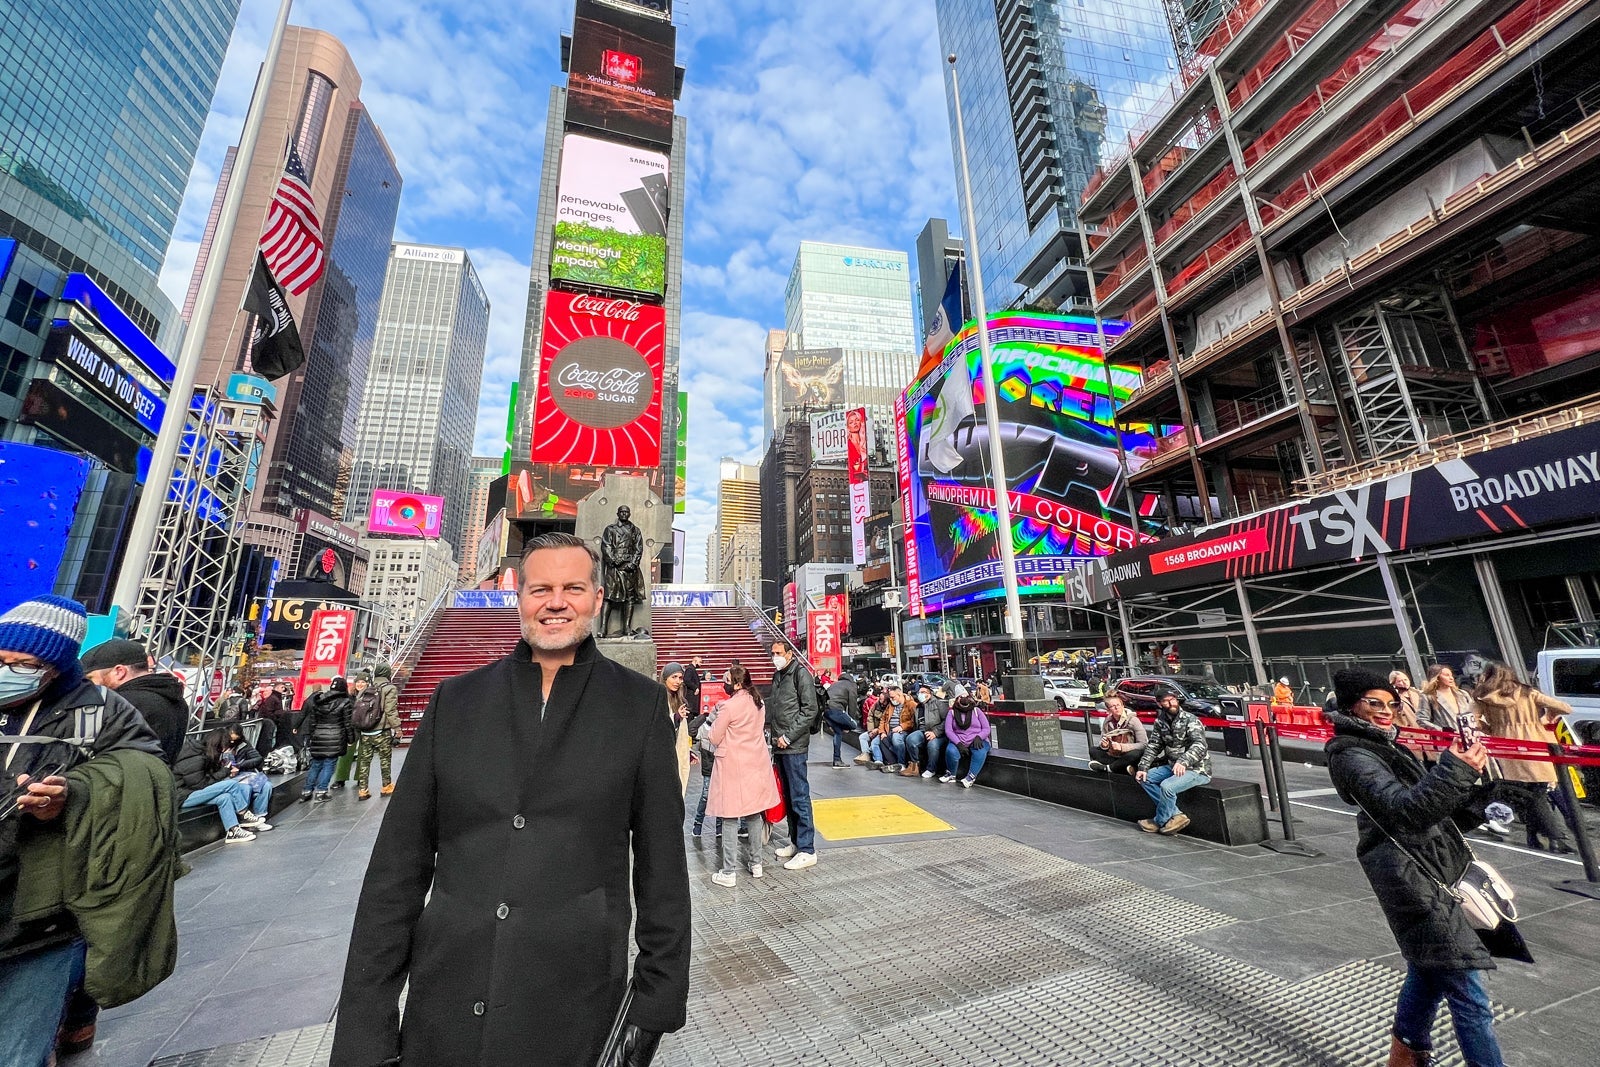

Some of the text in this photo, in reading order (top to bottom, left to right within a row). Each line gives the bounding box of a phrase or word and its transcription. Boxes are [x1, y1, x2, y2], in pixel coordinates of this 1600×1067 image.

[587, 74, 656, 97] Xinhua Screen Media
[629, 157, 665, 170] SAMSUNG
[559, 207, 615, 223] changes.
[560, 194, 626, 213] Renewable
[403, 248, 439, 260] Allianz
[556, 240, 621, 259] Meaningful
[855, 257, 902, 271] BARCLAYS
[569, 293, 644, 322] Coca-Cola
[67, 334, 156, 420] WHAT DO YOU SEE?
[558, 362, 646, 395] Coca-Cola
[597, 393, 635, 404] SUGAR
[816, 411, 845, 429] LITTLE
[817, 428, 847, 455] HORR
[897, 416, 911, 483] CHOCOLATE
[1450, 451, 1600, 512] BROADWAY
[1035, 500, 1140, 549] COLOR
[1289, 485, 1392, 558] TSX
[906, 539, 917, 577] COME
[1164, 538, 1247, 566] 1568 BROADWAY
[1066, 566, 1094, 606] TSX
[1101, 561, 1142, 587] BROADWAY
[315, 614, 347, 662] tkts
[815, 613, 835, 654] tkts
